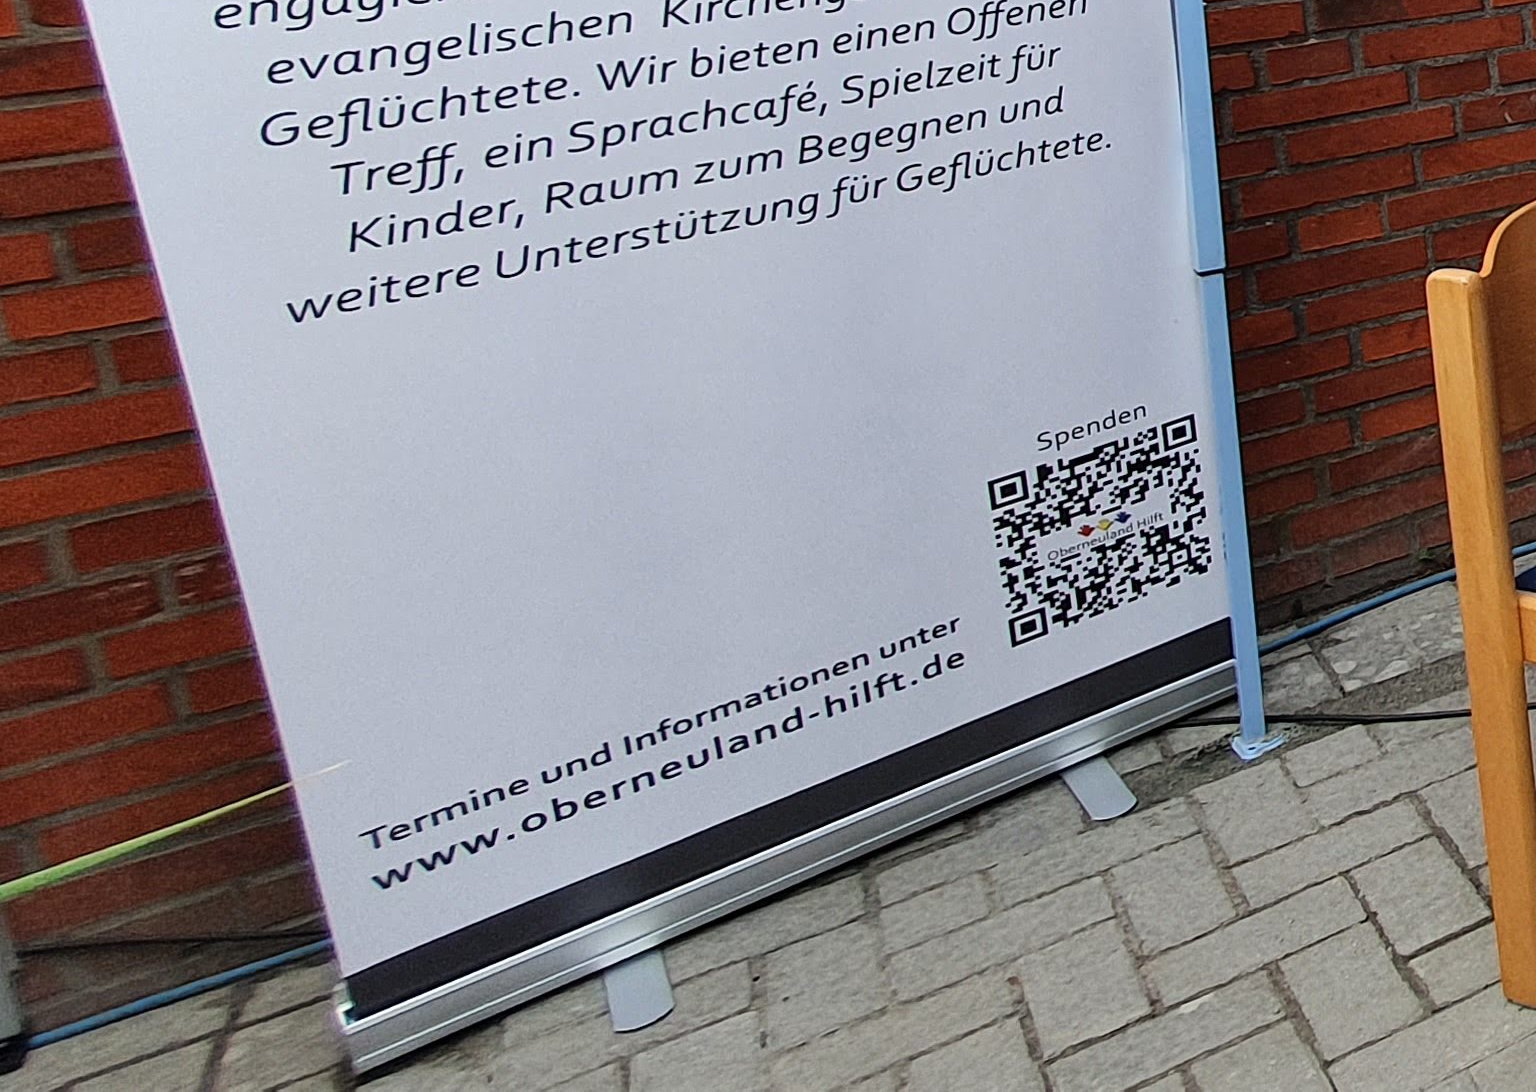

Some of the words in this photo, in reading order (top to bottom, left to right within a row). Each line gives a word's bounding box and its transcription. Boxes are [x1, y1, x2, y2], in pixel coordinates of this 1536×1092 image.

[261, 77, 581, 148] Geflüchtete.
[597, 54, 675, 92] Wir
[689, 34, 819, 78] bieten
[832, 17, 936, 57] einen
[267, 11, 632, 85] evangelischen
[330, 142, 464, 196] Treff,
[485, 133, 553, 169] ein
[568, 82, 828, 158] Sprachcafé,
[842, 53, 1002, 109] Spielzeit
[1006, 44, 1062, 85] für
[286, 264, 481, 324] weitere
[497, 192, 821, 281] Unterstützung
[827, 172, 888, 219] für
[896, 131, 1112, 195] Geflüchtete.
[350, 198, 524, 253] Kinder,
[546, 164, 679, 214] Raum
[694, 144, 784, 183] zum
[799, 103, 987, 165] Begegnen
[999, 86, 1064, 124] und
[1036, 405, 1147, 453] Spenden
[1048, 523, 1133, 560] Oberneuland
[1137, 512, 1164, 529] Hilft
[358, 778, 530, 850] Termine
[541, 741, 613, 785] und
[624, 653, 870, 756] Informationen
[880, 617, 961, 660] unter
[371, 652, 966, 890] www.oberneuland-hilft.de
